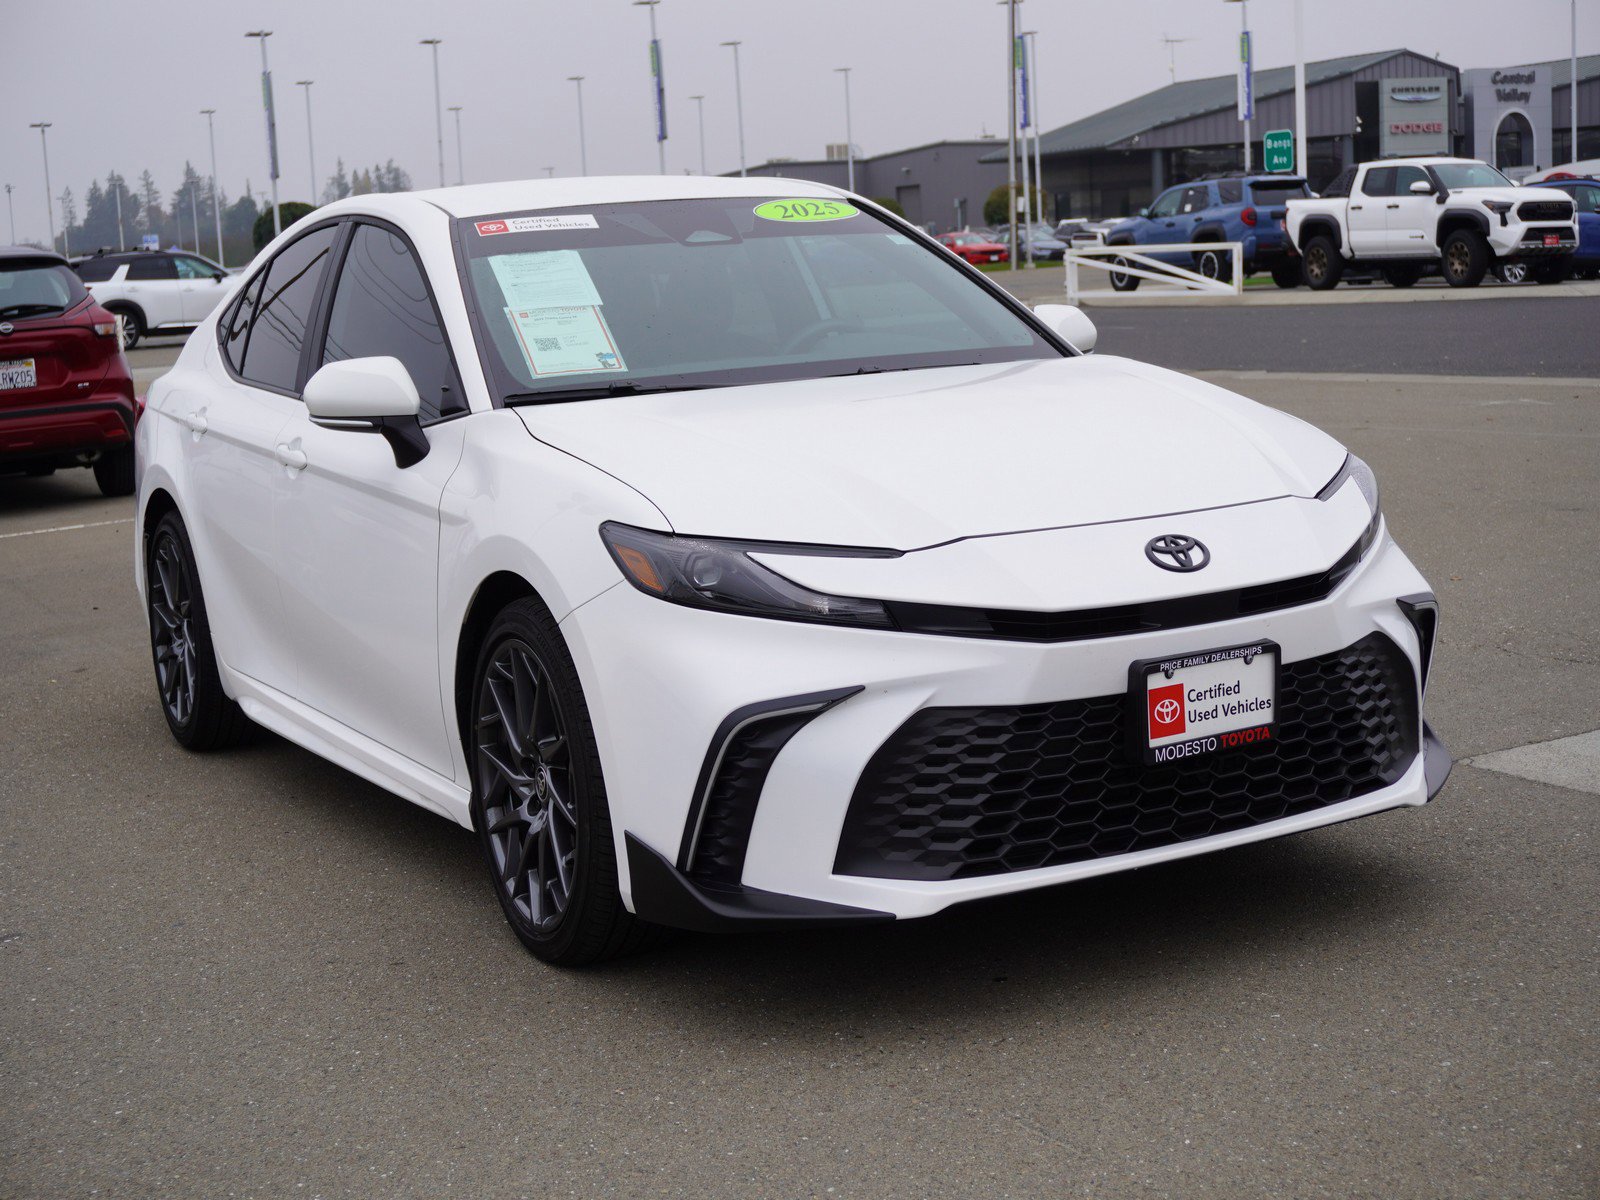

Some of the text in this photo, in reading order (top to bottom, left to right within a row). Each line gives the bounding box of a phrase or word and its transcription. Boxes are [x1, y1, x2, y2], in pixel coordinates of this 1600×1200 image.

[1491, 71, 1535, 85] Central
[1495, 88, 1531, 104] Valley
[1390, 122, 1444, 134] DODGE
[1266, 138, 1291, 150] Bangs
[1272, 155, 1288, 165] Ave
[774, 202, 840, 219] 2025
[512, 217, 561, 225] Certified
[0, 370, 33, 385] RW205
[1160, 646, 1262, 672] PRICE FAMILY DEALERSHIPS
[1187, 680, 1240, 702] Certified
[1188, 697, 1272, 723] Used Vehicles
[1155, 726, 1271, 763] MODESTO TOYOTA
